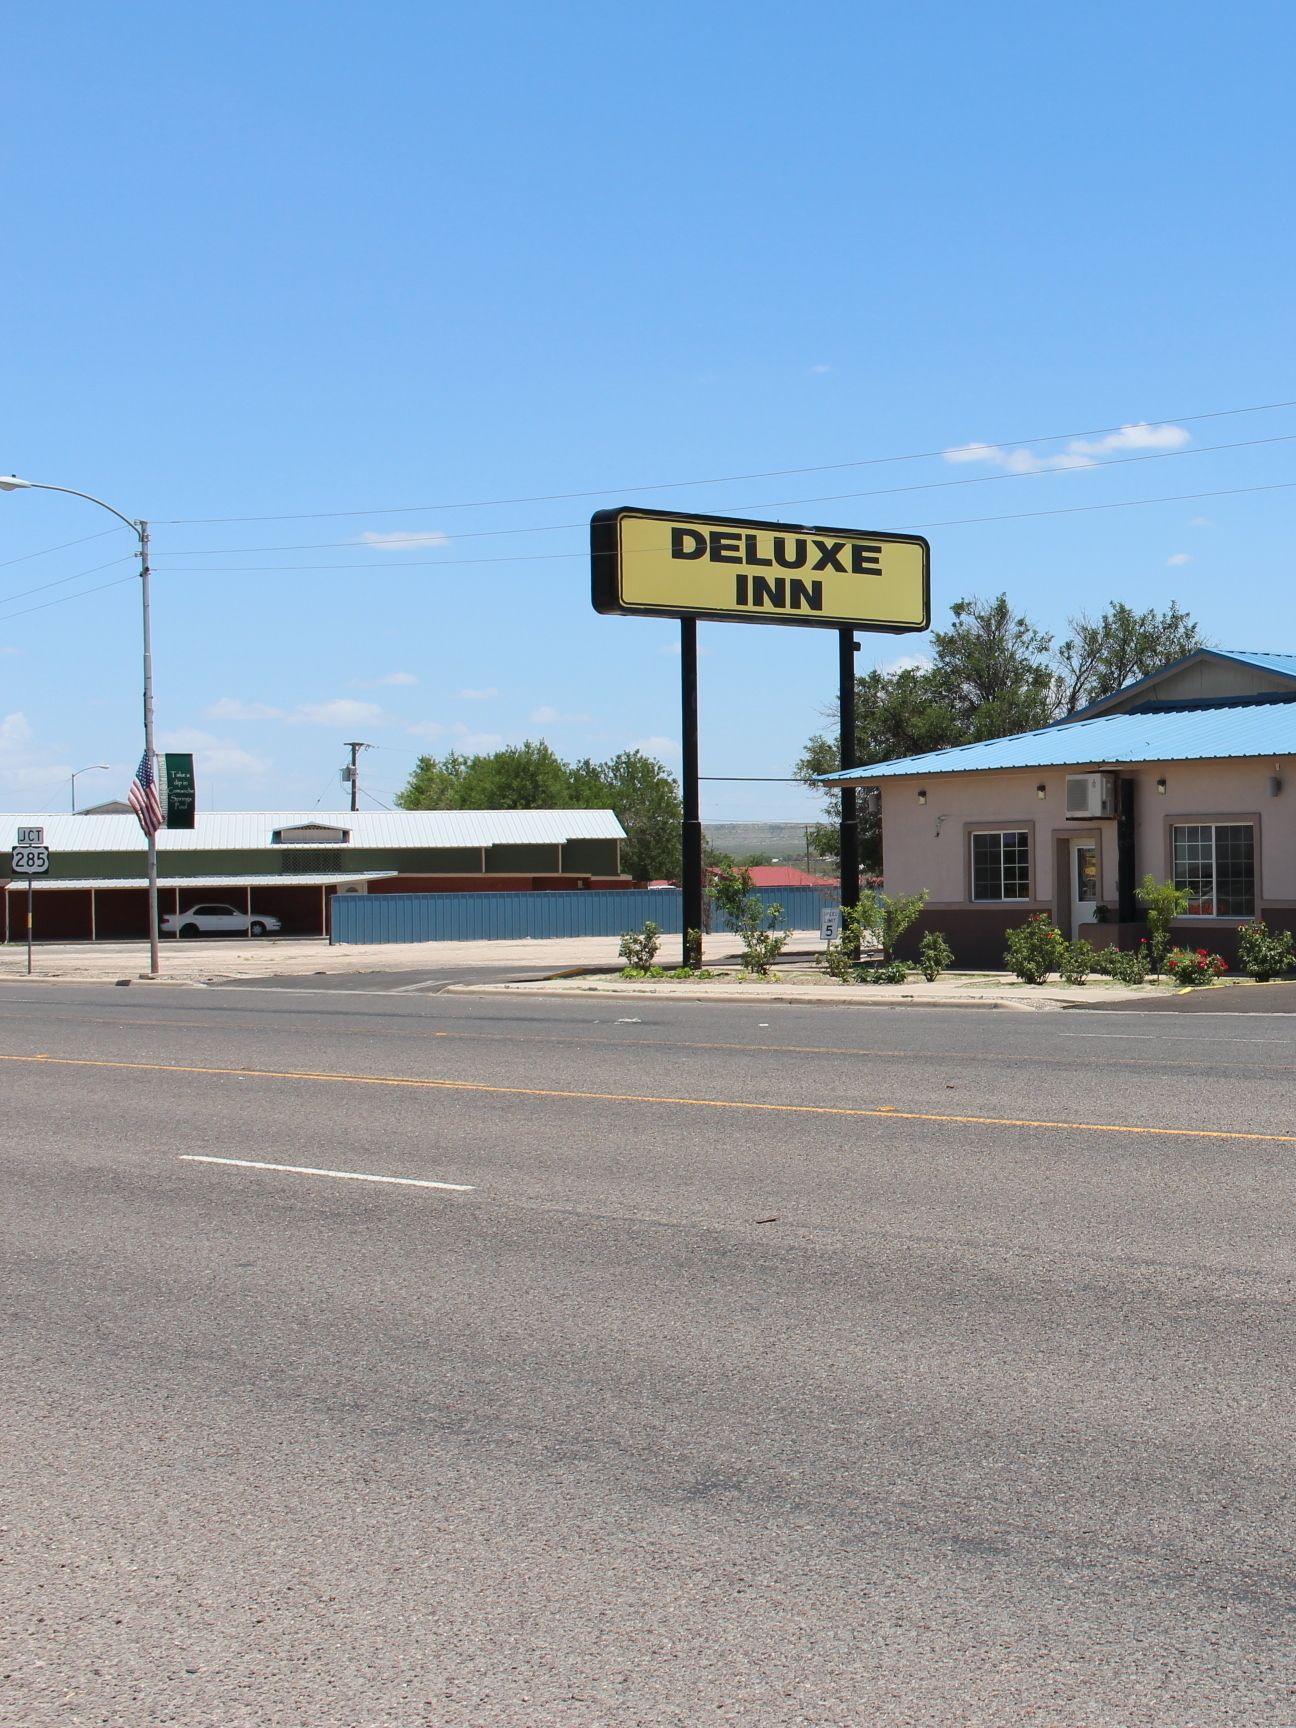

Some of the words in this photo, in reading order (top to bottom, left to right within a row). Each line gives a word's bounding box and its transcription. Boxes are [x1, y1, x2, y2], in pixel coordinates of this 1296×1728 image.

[670, 526, 883, 577] DELUXE
[735, 573, 823, 612] INN
[169, 770, 186, 778] Take
[173, 779, 183, 788] dip
[170, 794, 193, 803] Springs
[19, 830, 42, 842] JCT
[15, 851, 46, 868] 285
[825, 925, 833, 937] 5
